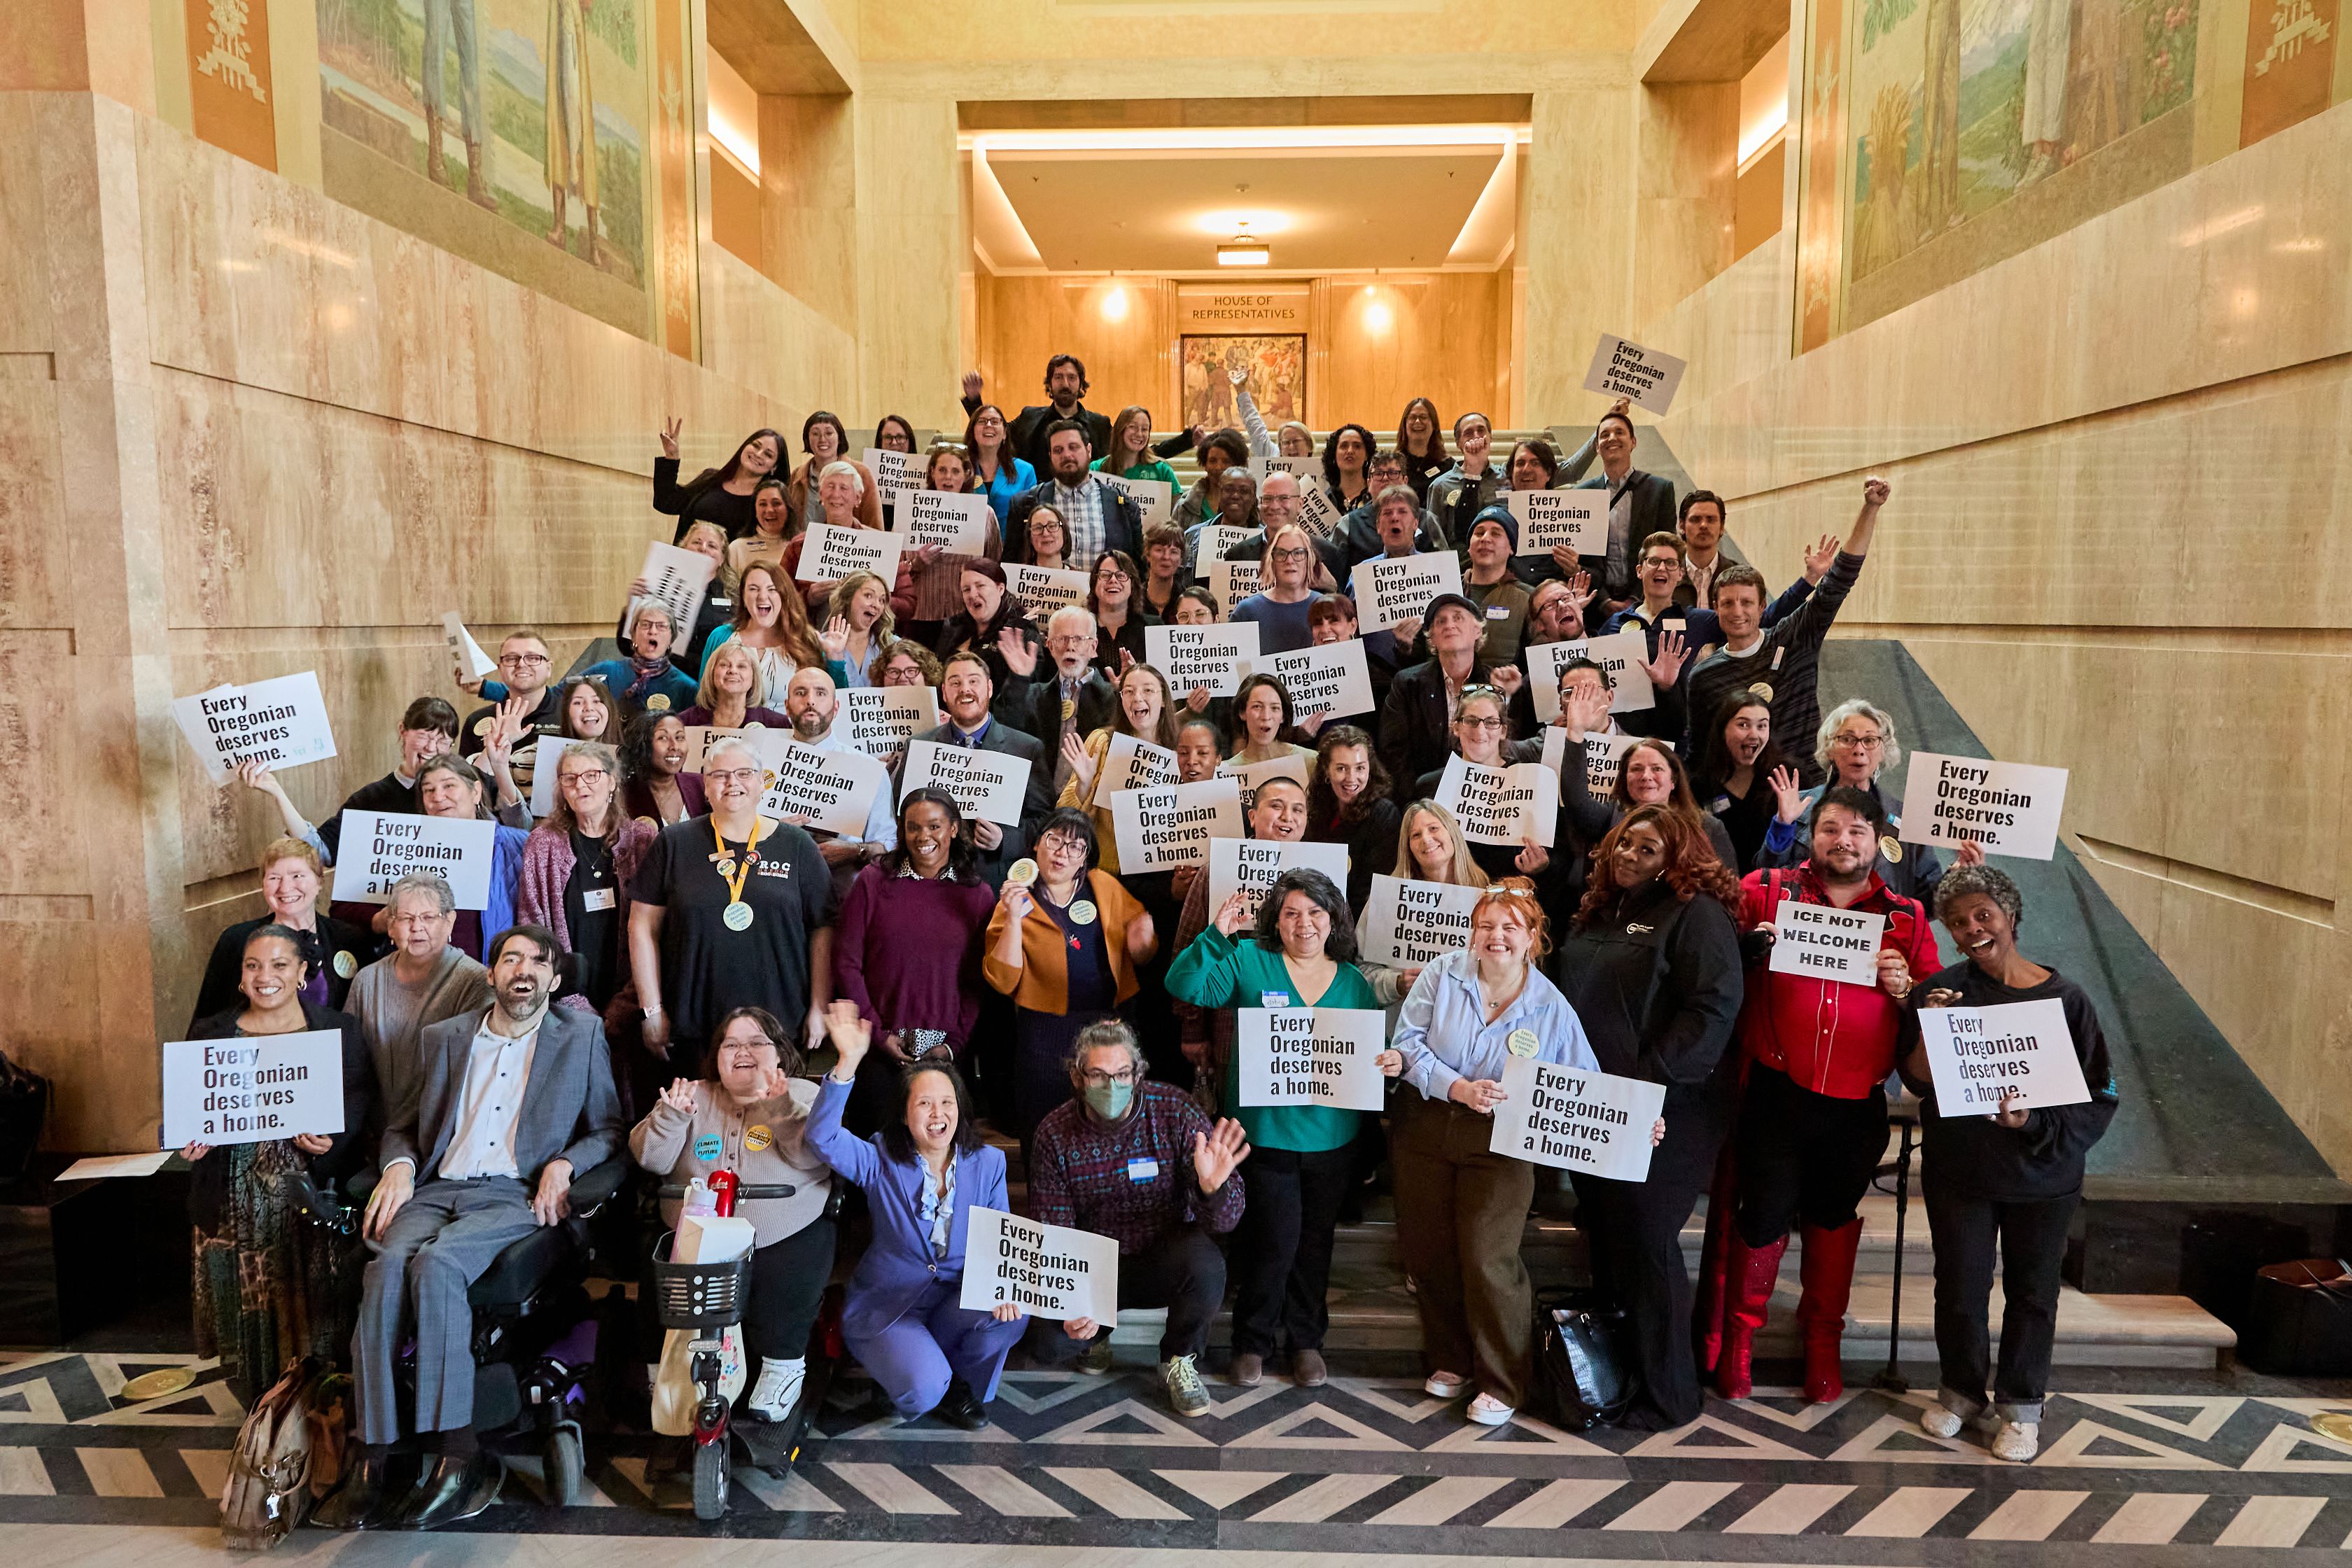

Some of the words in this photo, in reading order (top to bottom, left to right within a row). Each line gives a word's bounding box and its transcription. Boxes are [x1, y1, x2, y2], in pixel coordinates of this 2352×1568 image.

[1215, 297, 1252, 305] HOUSE
[1257, 296, 1273, 305] OF
[1193, 309, 1294, 319] REPRESENTATIVES
[1616, 342, 1644, 361] Every
[1612, 353, 1665, 380] Oregonian
[1607, 365, 1653, 389] deserves
[1602, 380, 1610, 388] a
[1611, 379, 1641, 400] home.
[881, 454, 906, 468] Every
[1266, 460, 1292, 472] Every
[878, 477, 920, 489] deserves
[913, 493, 941, 507] Every
[1308, 488, 1329, 515] Every
[1529, 494, 1560, 508] Every
[913, 507, 967, 522] Oregonian
[1303, 496, 1331, 540] regonia
[1529, 507, 1590, 522] Oregonian
[911, 520, 959, 533] deserves
[1219, 528, 1247, 540] Every
[1529, 521, 1581, 533] deserves
[827, 528, 857, 545] Every
[910, 536, 915, 544] a
[920, 533, 952, 546] home.
[1529, 539, 1534, 548] a
[1539, 535, 1575, 547] home.
[824, 541, 881, 558] Oregonian
[821, 554, 870, 569] deserves
[1373, 564, 1406, 578] Every
[1019, 568, 1051, 584] Every
[1231, 565, 1261, 579] Every
[1018, 582, 1077, 598] Oregonian
[1376, 573, 1440, 592] Oregonian
[1378, 590, 1433, 608] deserves
[1380, 612, 1386, 622] a
[1169, 630, 1204, 645] Every
[1170, 644, 1238, 661] Oregonian
[1552, 648, 1588, 662] Every
[1171, 661, 1228, 675] deserves
[1275, 656, 1310, 671] Every
[1171, 680, 1178, 691] a
[1183, 676, 1223, 690] home.
[1278, 666, 1345, 687] Oregonian
[848, 692, 884, 707] Every
[1290, 684, 1339, 701] eserves
[200, 696, 246, 715] Every
[850, 706, 919, 723] Oregonian
[1295, 701, 1335, 717] home.
[208, 706, 296, 734] Oregonian
[216, 727, 289, 752] deserves
[853, 725, 911, 738] deserves
[785, 745, 825, 769] Every
[1134, 743, 1170, 769] Every
[1588, 740, 1611, 755] ery
[223, 758, 234, 769] a
[233, 748, 286, 764] home.
[934, 748, 972, 767] Every
[780, 762, 853, 791] Oregonian
[931, 763, 1002, 785] Oregonian
[1130, 760, 1183, 785] Oregon
[1465, 767, 1505, 789] Every
[1940, 760, 1989, 785] Every
[774, 778, 837, 804] deserves
[1461, 784, 1533, 805] Oregonian
[1938, 780, 2031, 808] Oregonian
[768, 798, 777, 808] a
[780, 797, 822, 820] home.
[955, 802, 978, 811] me.
[1138, 794, 1177, 809] Every
[1457, 801, 1520, 819] deserves
[1140, 807, 1217, 828] Oregonian
[1934, 800, 2014, 826] deserves
[375, 818, 421, 840] Every
[1142, 827, 1208, 846] deserves
[1466, 818, 1509, 836] home.
[1931, 824, 1940, 836] a
[1947, 821, 2000, 844] home.
[373, 839, 462, 860] Oregonian
[1144, 852, 1152, 863] a
[1156, 846, 1203, 862] home.
[1239, 845, 1281, 866] Every
[759, 860, 790, 871] ROC
[367, 882, 376, 893] a
[1238, 883, 1272, 900] dese
[1399, 884, 1442, 907] Every
[1793, 910, 1823, 923] ICE
[1829, 916, 1866, 929] NOT
[1394, 923, 1466, 947] deserves
[1784, 928, 1870, 951] WELCOME
[1392, 946, 1400, 958] a
[1406, 944, 1441, 962] hom
[1800, 952, 1847, 970] HERE
[1270, 1014, 1315, 1035] Every
[1947, 1014, 1982, 1036] Every
[1270, 1035, 1354, 1056] Oregonian
[1953, 1033, 2038, 1060] Oregonian
[204, 1046, 260, 1066] Every
[1271, 1056, 1342, 1076] deserves
[1959, 1060, 2030, 1079] deserves
[204, 1063, 308, 1090] Oregonian
[1536, 1067, 1586, 1096] Every
[1271, 1082, 1280, 1095] a
[1287, 1077, 1334, 1096] home.
[1964, 1088, 1974, 1102] a
[1976, 1082, 2027, 1102] home.
[204, 1089, 294, 1112] deserves
[1532, 1089, 1628, 1125] Oregonian
[203, 1120, 214, 1135] a
[223, 1113, 284, 1133] home.
[1528, 1110, 1610, 1144] deserves
[1524, 1137, 1534, 1150] a
[1541, 1135, 1595, 1163] home.
[1001, 1218, 1044, 1249] Every
[1000, 1239, 1088, 1273] Oregonian
[997, 1260, 1074, 1291] deserves
[995, 1287, 1004, 1300] a
[1012, 1282, 1064, 1310] home.
